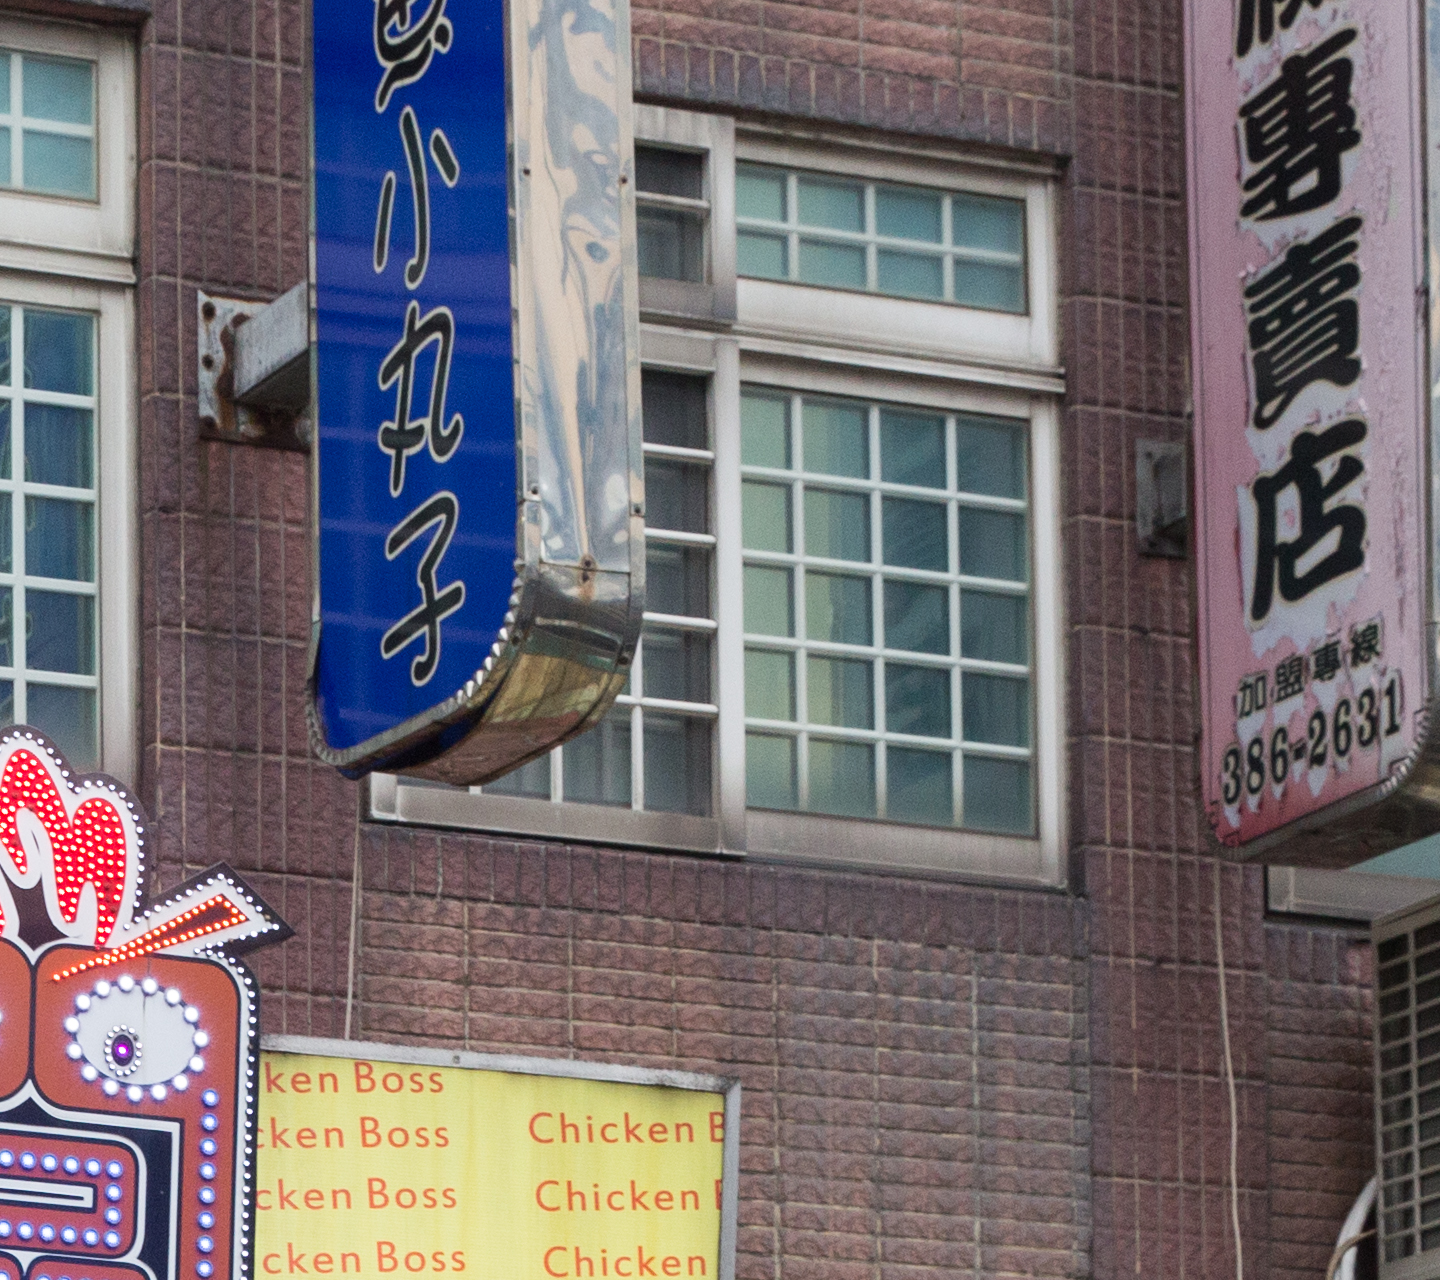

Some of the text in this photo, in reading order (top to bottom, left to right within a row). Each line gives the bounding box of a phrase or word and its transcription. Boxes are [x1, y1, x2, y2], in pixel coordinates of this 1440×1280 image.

[1237, 618, 1384, 718] 加盟專線
[1222, 676, 1401, 804] 386-2631
[354, 1061, 443, 1093] Boss
[360, 1116, 449, 1148] Boss
[529, 1112, 694, 1144] Chicken
[368, 1177, 456, 1209] Boss
[536, 1180, 699, 1212] Chicken
[377, 1241, 465, 1272] Boss
[544, 1246, 706, 1278] Chicken
